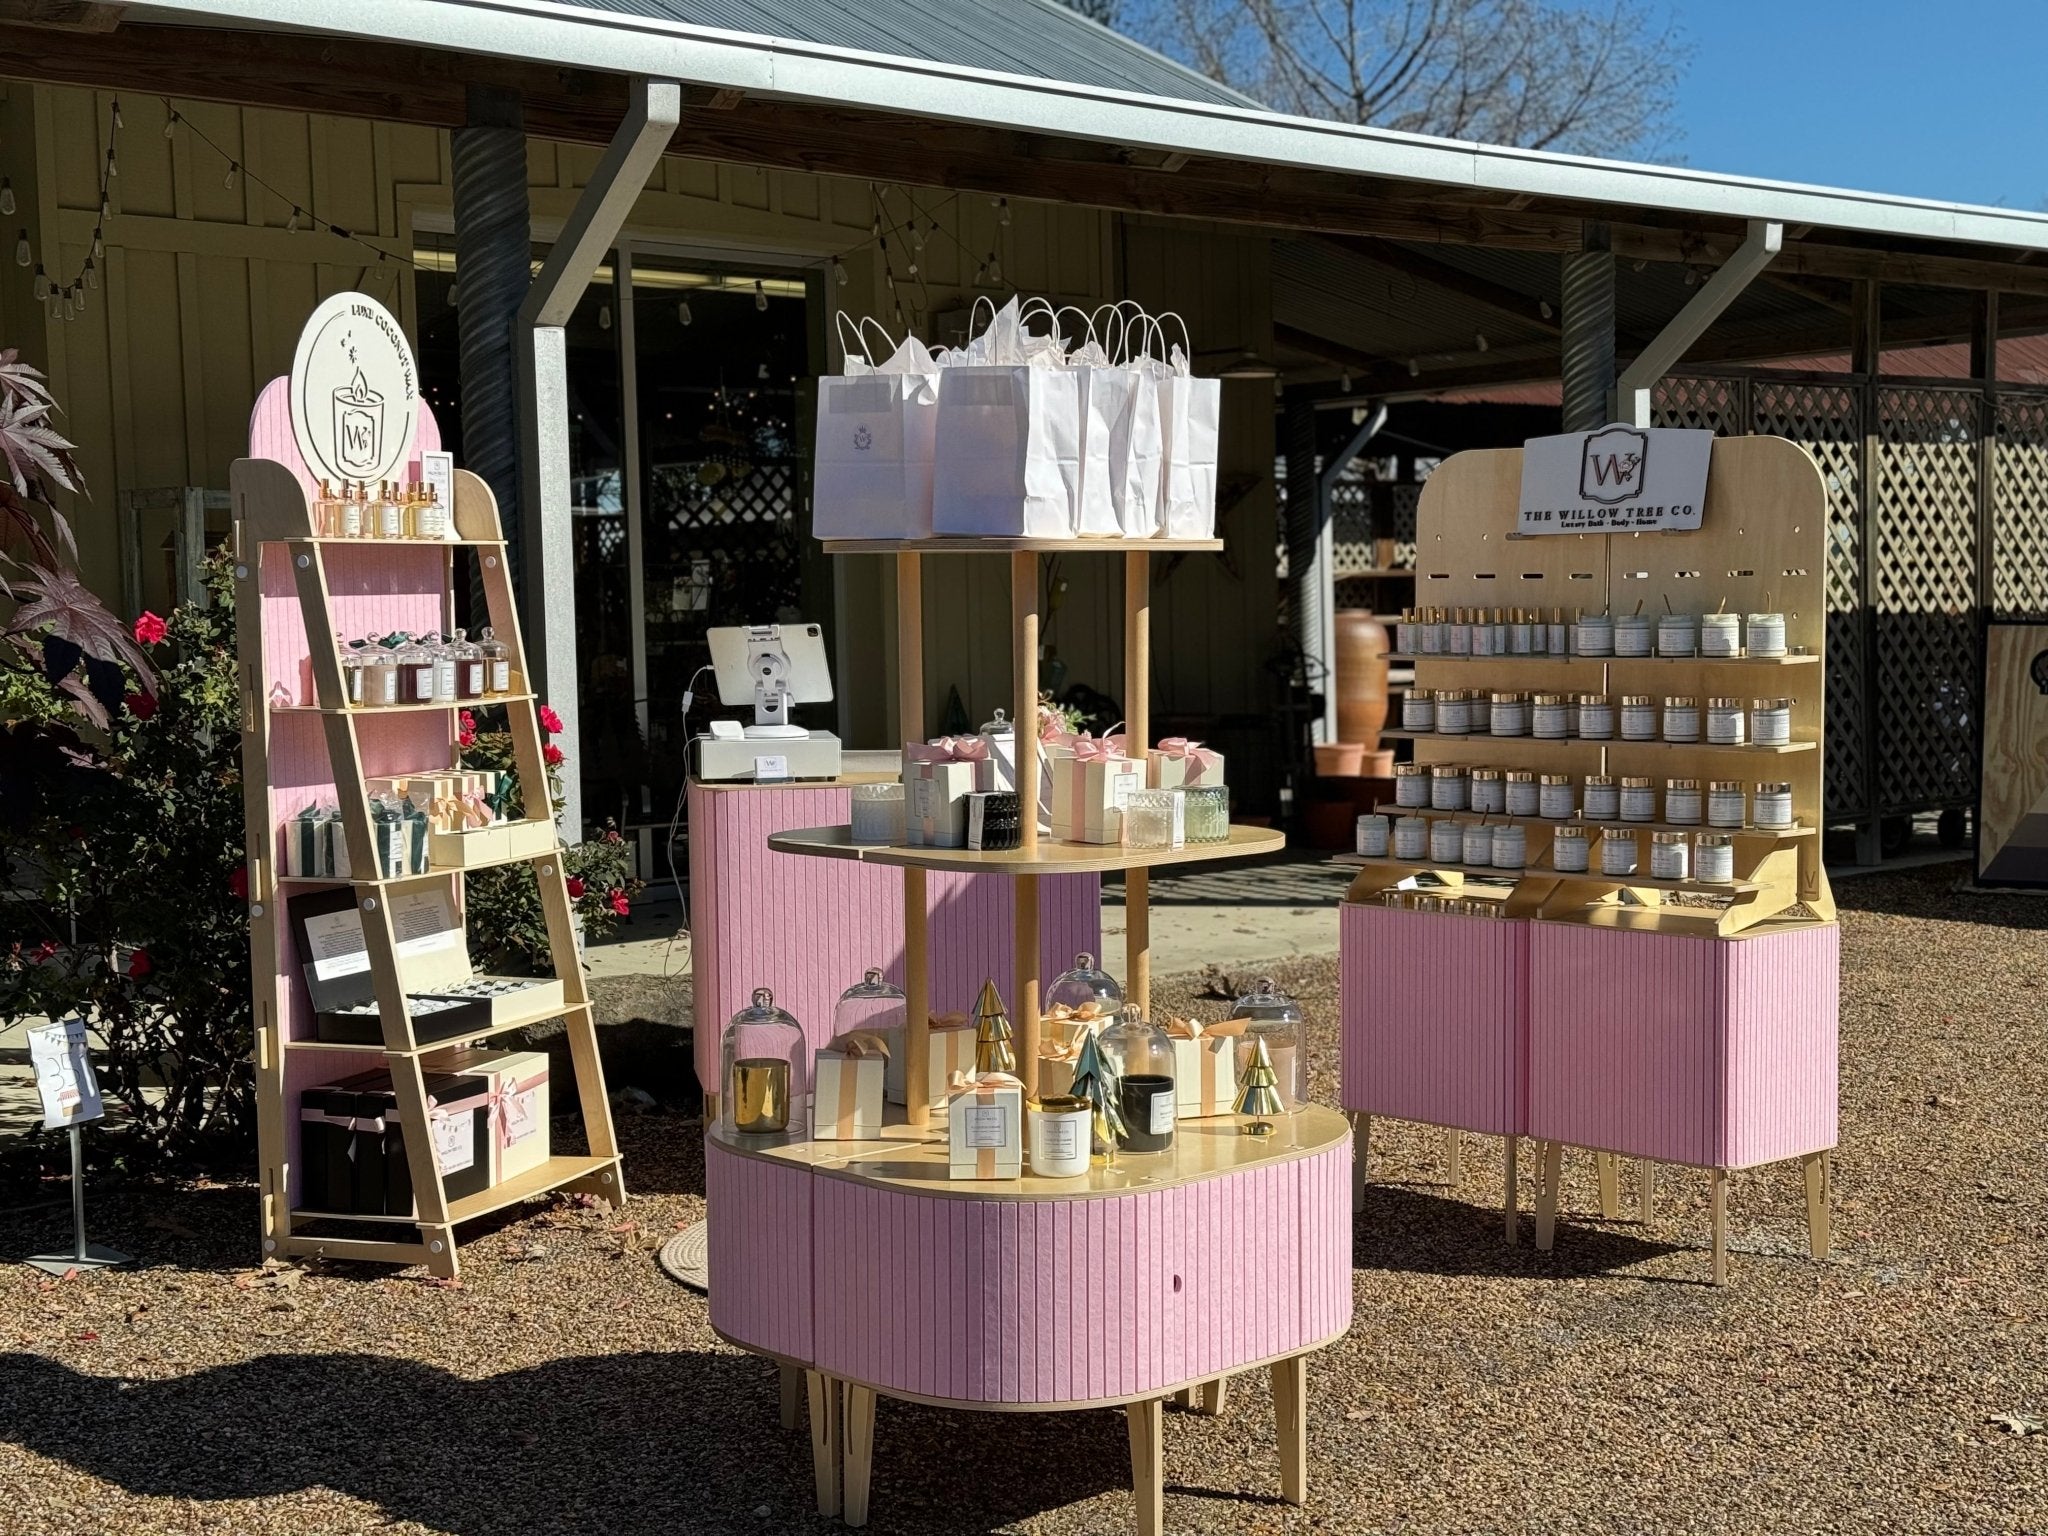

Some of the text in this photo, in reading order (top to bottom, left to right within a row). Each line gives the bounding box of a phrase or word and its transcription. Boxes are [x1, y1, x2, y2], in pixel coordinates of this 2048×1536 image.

[1589, 453, 1636, 486] W
[1523, 504, 1696, 522] THE WILLOW TREE CO.
[1561, 518, 1657, 529] Luxury Bath Body Home
[46, 1052, 81, 1092] 35
